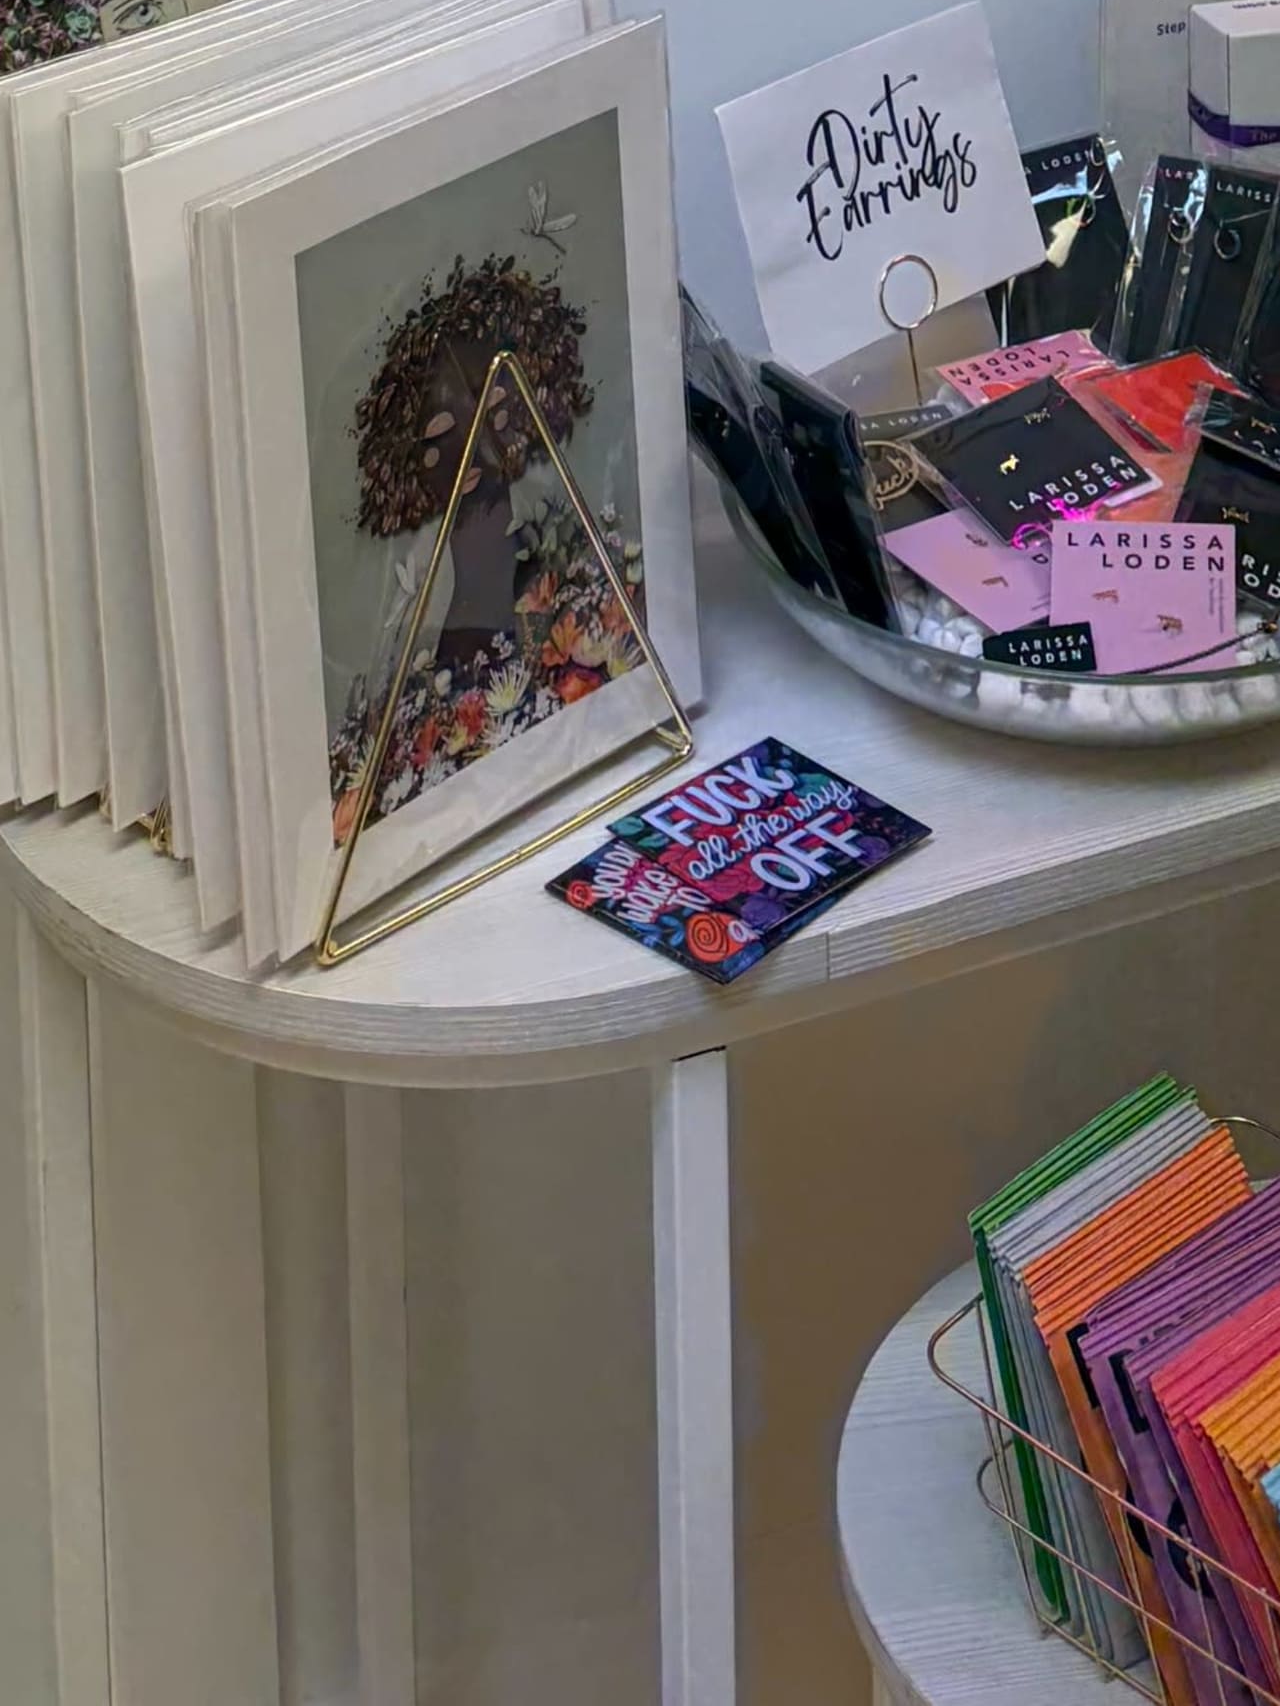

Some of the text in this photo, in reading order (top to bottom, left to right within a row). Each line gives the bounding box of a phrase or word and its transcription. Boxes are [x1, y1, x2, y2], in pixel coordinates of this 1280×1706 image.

[1155, 19, 1187, 37] Step
[806, 73, 941, 201] Dirty
[795, 132, 977, 261] Earrings
[1215, 181, 1274, 204] LARISS
[1008, 454, 1127, 512] LARISSA
[1045, 467, 1139, 514] LODEN
[1066, 531, 1225, 552] LARISSA
[1101, 552, 1226, 572] LODEN
[1007, 633, 1089, 655] LARISSA
[1019, 649, 1084, 667] LODEN
[639, 755, 795, 848] FUCK
[687, 837, 739, 882] all
[734, 805, 790, 855] the
[788, 779, 856, 824] way
[749, 811, 867, 892] OFF
